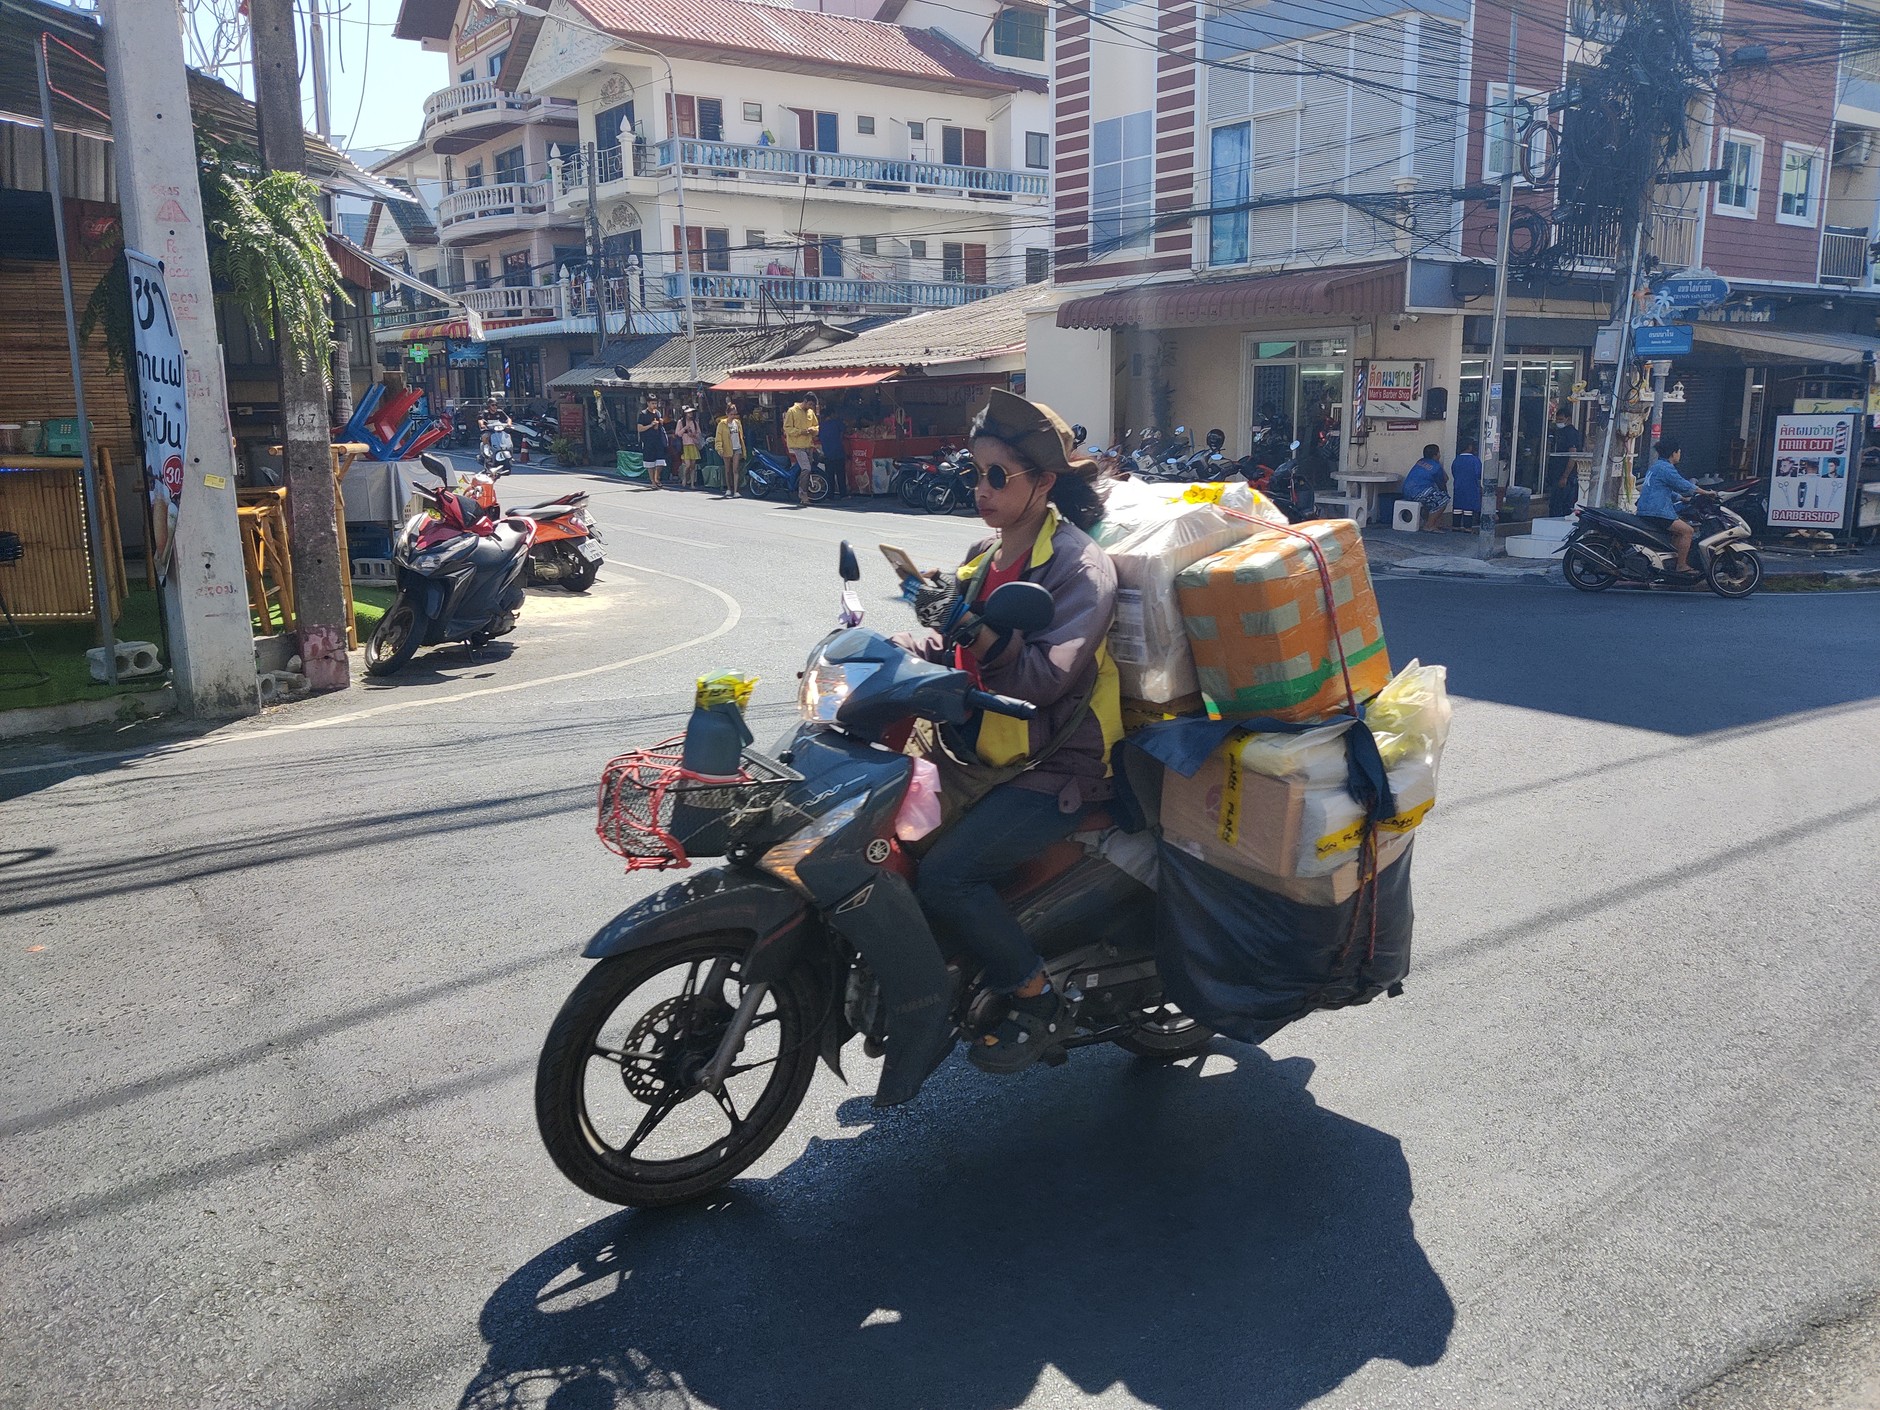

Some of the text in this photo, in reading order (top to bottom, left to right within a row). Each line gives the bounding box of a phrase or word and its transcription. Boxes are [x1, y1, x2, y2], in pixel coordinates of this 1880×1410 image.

[133, 276, 174, 337] ชา
[137, 350, 181, 388] กาแฟ
[1369, 364, 1413, 387] ตัดผมชาย
[1369, 389, 1410, 400] Men's Barber Shop
[1779, 423, 1835, 436] ตัดผมชาย
[1780, 439, 1832, 450] HAIR CUT
[1772, 509, 1840, 522] BARBERSHOP
